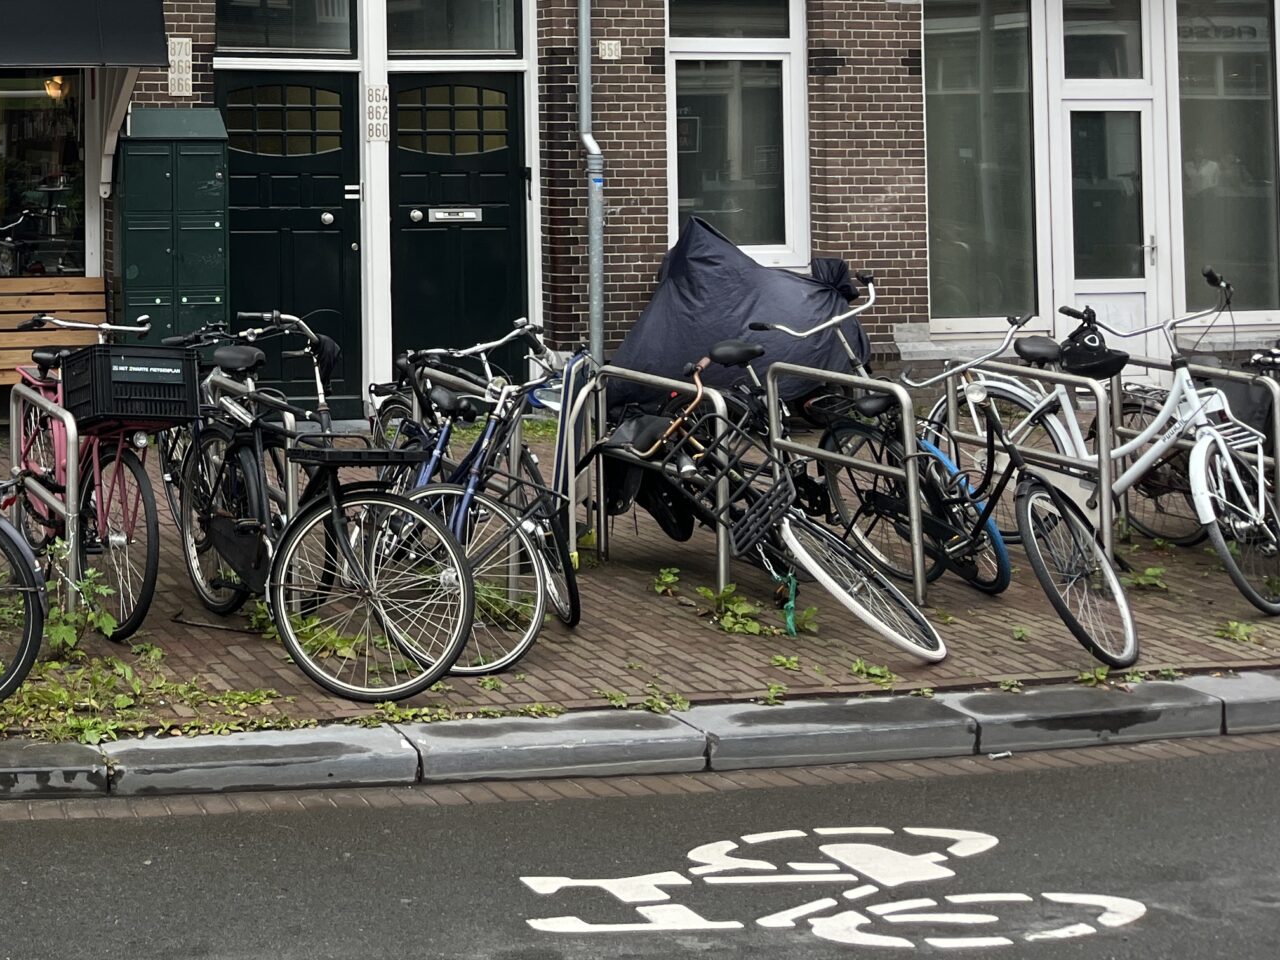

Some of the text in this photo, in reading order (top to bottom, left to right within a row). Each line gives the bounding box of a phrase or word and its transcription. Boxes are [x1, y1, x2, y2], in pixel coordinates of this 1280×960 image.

[170, 41, 191, 56] 870
[600, 42, 620, 57] 858
[170, 59, 191, 74] 868
[170, 77, 191, 93] 866
[367, 88, 388, 103] 864
[367, 105, 388, 120] 862
[367, 122, 389, 138] 860
